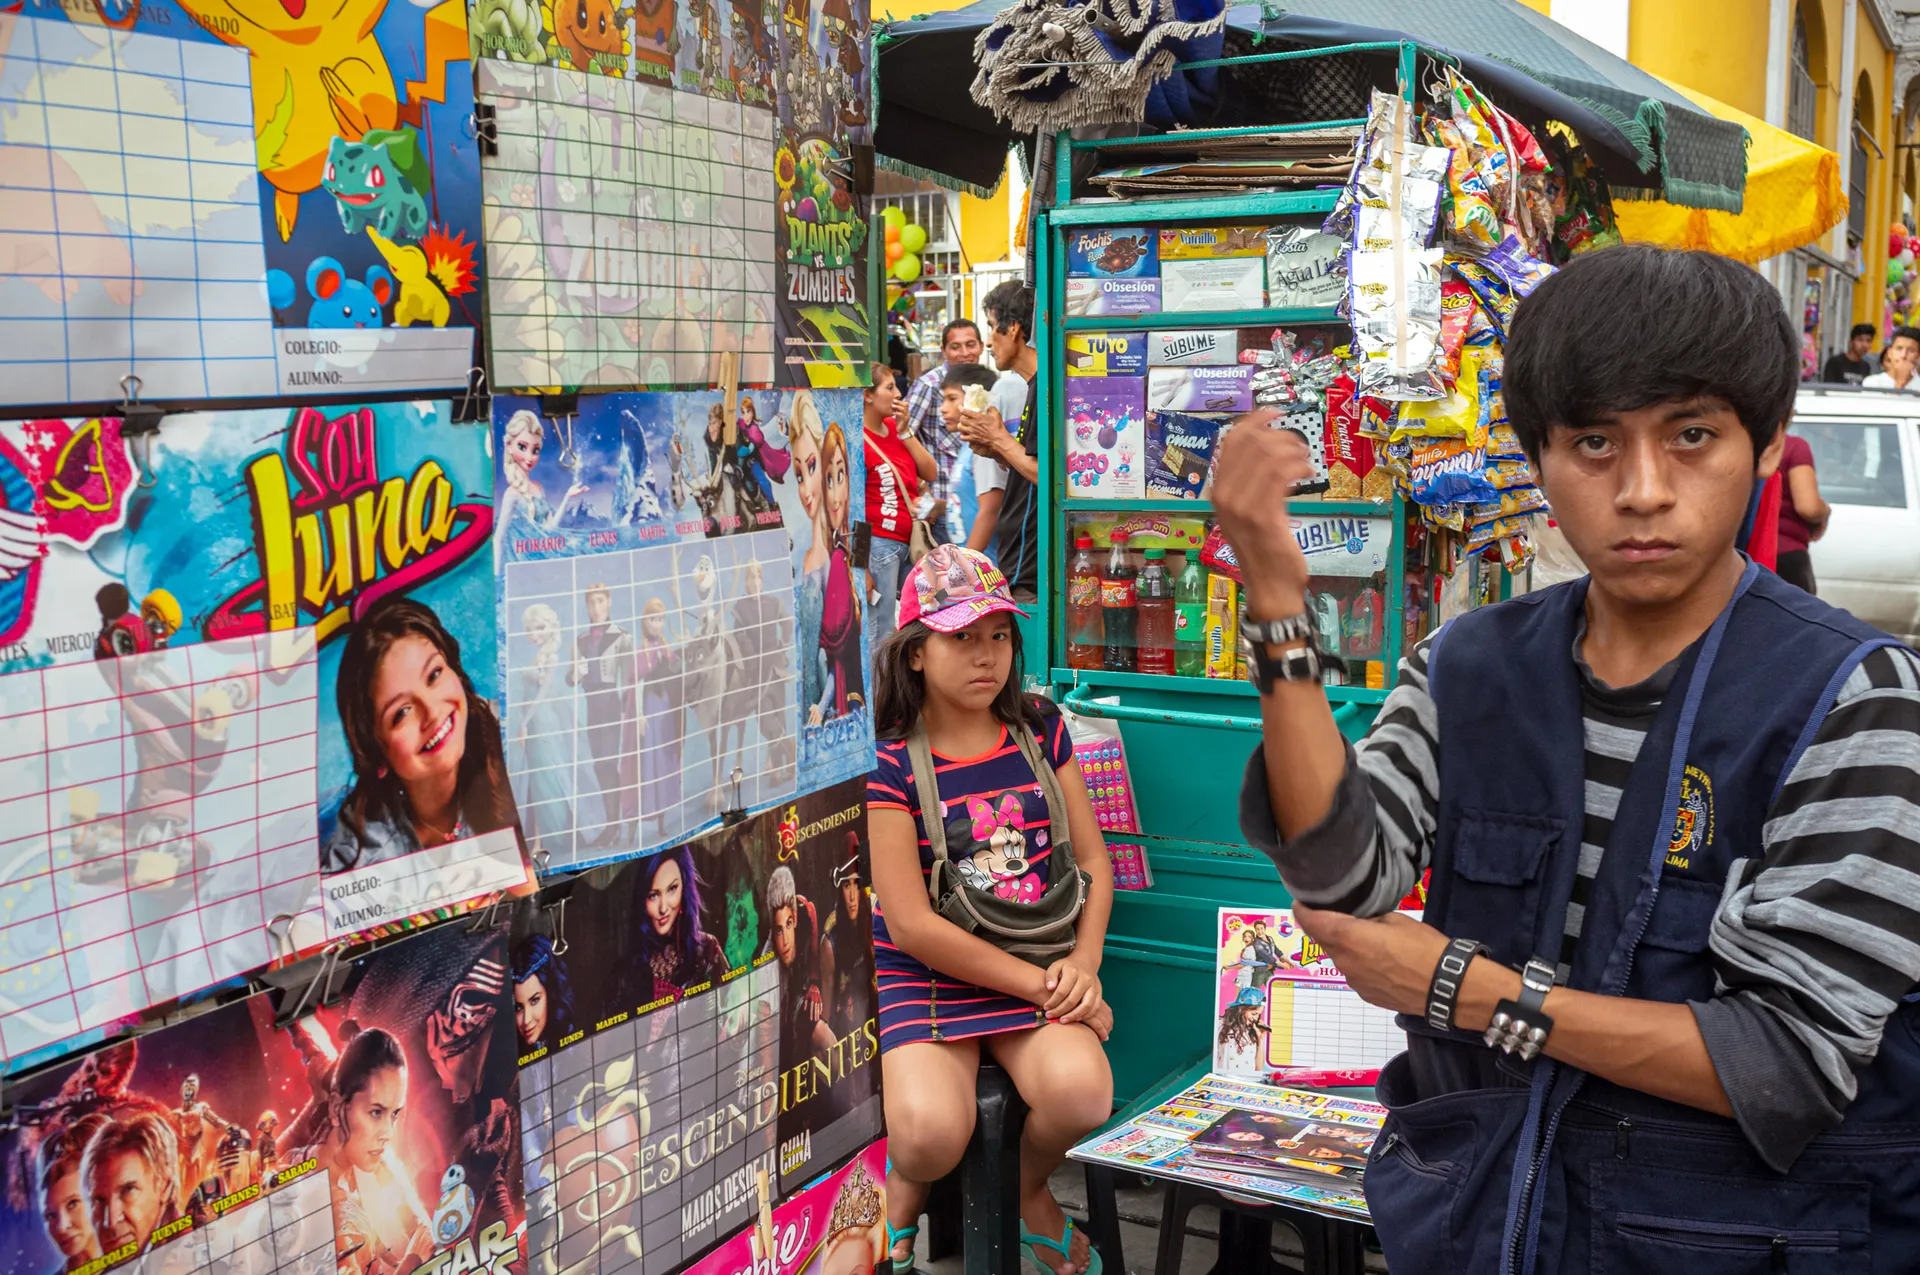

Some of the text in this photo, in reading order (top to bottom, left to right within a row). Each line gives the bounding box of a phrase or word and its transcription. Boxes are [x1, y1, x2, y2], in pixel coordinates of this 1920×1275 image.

[483, 32, 528, 55] HORARIO
[595, 52, 627, 69] MARTES
[786, 214, 852, 258] PLANTS
[1077, 231, 1113, 254] Fochis
[1180, 231, 1217, 245] Vainilla
[1275, 240, 1308, 254] Costa
[814, 254, 825, 268] VS.
[787, 263, 856, 304] ZOMBIES
[1103, 281, 1155, 293] Obsesión
[1277, 266, 1314, 291] Agua
[285, 340, 342, 355] COLEGIO:
[1088, 337, 1128, 354] TUYO
[1163, 333, 1217, 358] SUBLIME
[287, 371, 342, 386] ALUMNO:
[1193, 368, 1248, 379] Obsesión
[515, 535, 566, 554] HORARIO
[589, 531, 618, 548] LUNES
[639, 526, 667, 542] MARTES
[1295, 518, 1370, 551] UBLIME
[1210, 626, 1222, 662] Vainilla
[802, 708, 869, 763] FROZEN
[1665, 854, 1689, 869] LIMA
[330, 875, 382, 901] COLEGIO:
[334, 904, 386, 930] ALUMNO:
[559, 1030, 584, 1048] LUNES
[596, 1012, 628, 1032] MARTES
[637, 994, 675, 1015] MIERCOLES
[683, 980, 711, 998] JUEVES
[721, 964, 748, 982] VIERNES
[150, 1214, 193, 1245] JUEVES
[212, 1184, 260, 1214] VIERNES
[277, 1158, 318, 1185] SABADO
[682, 1186, 723, 1244] MALOS
[724, 1159, 764, 1214] DESDE
